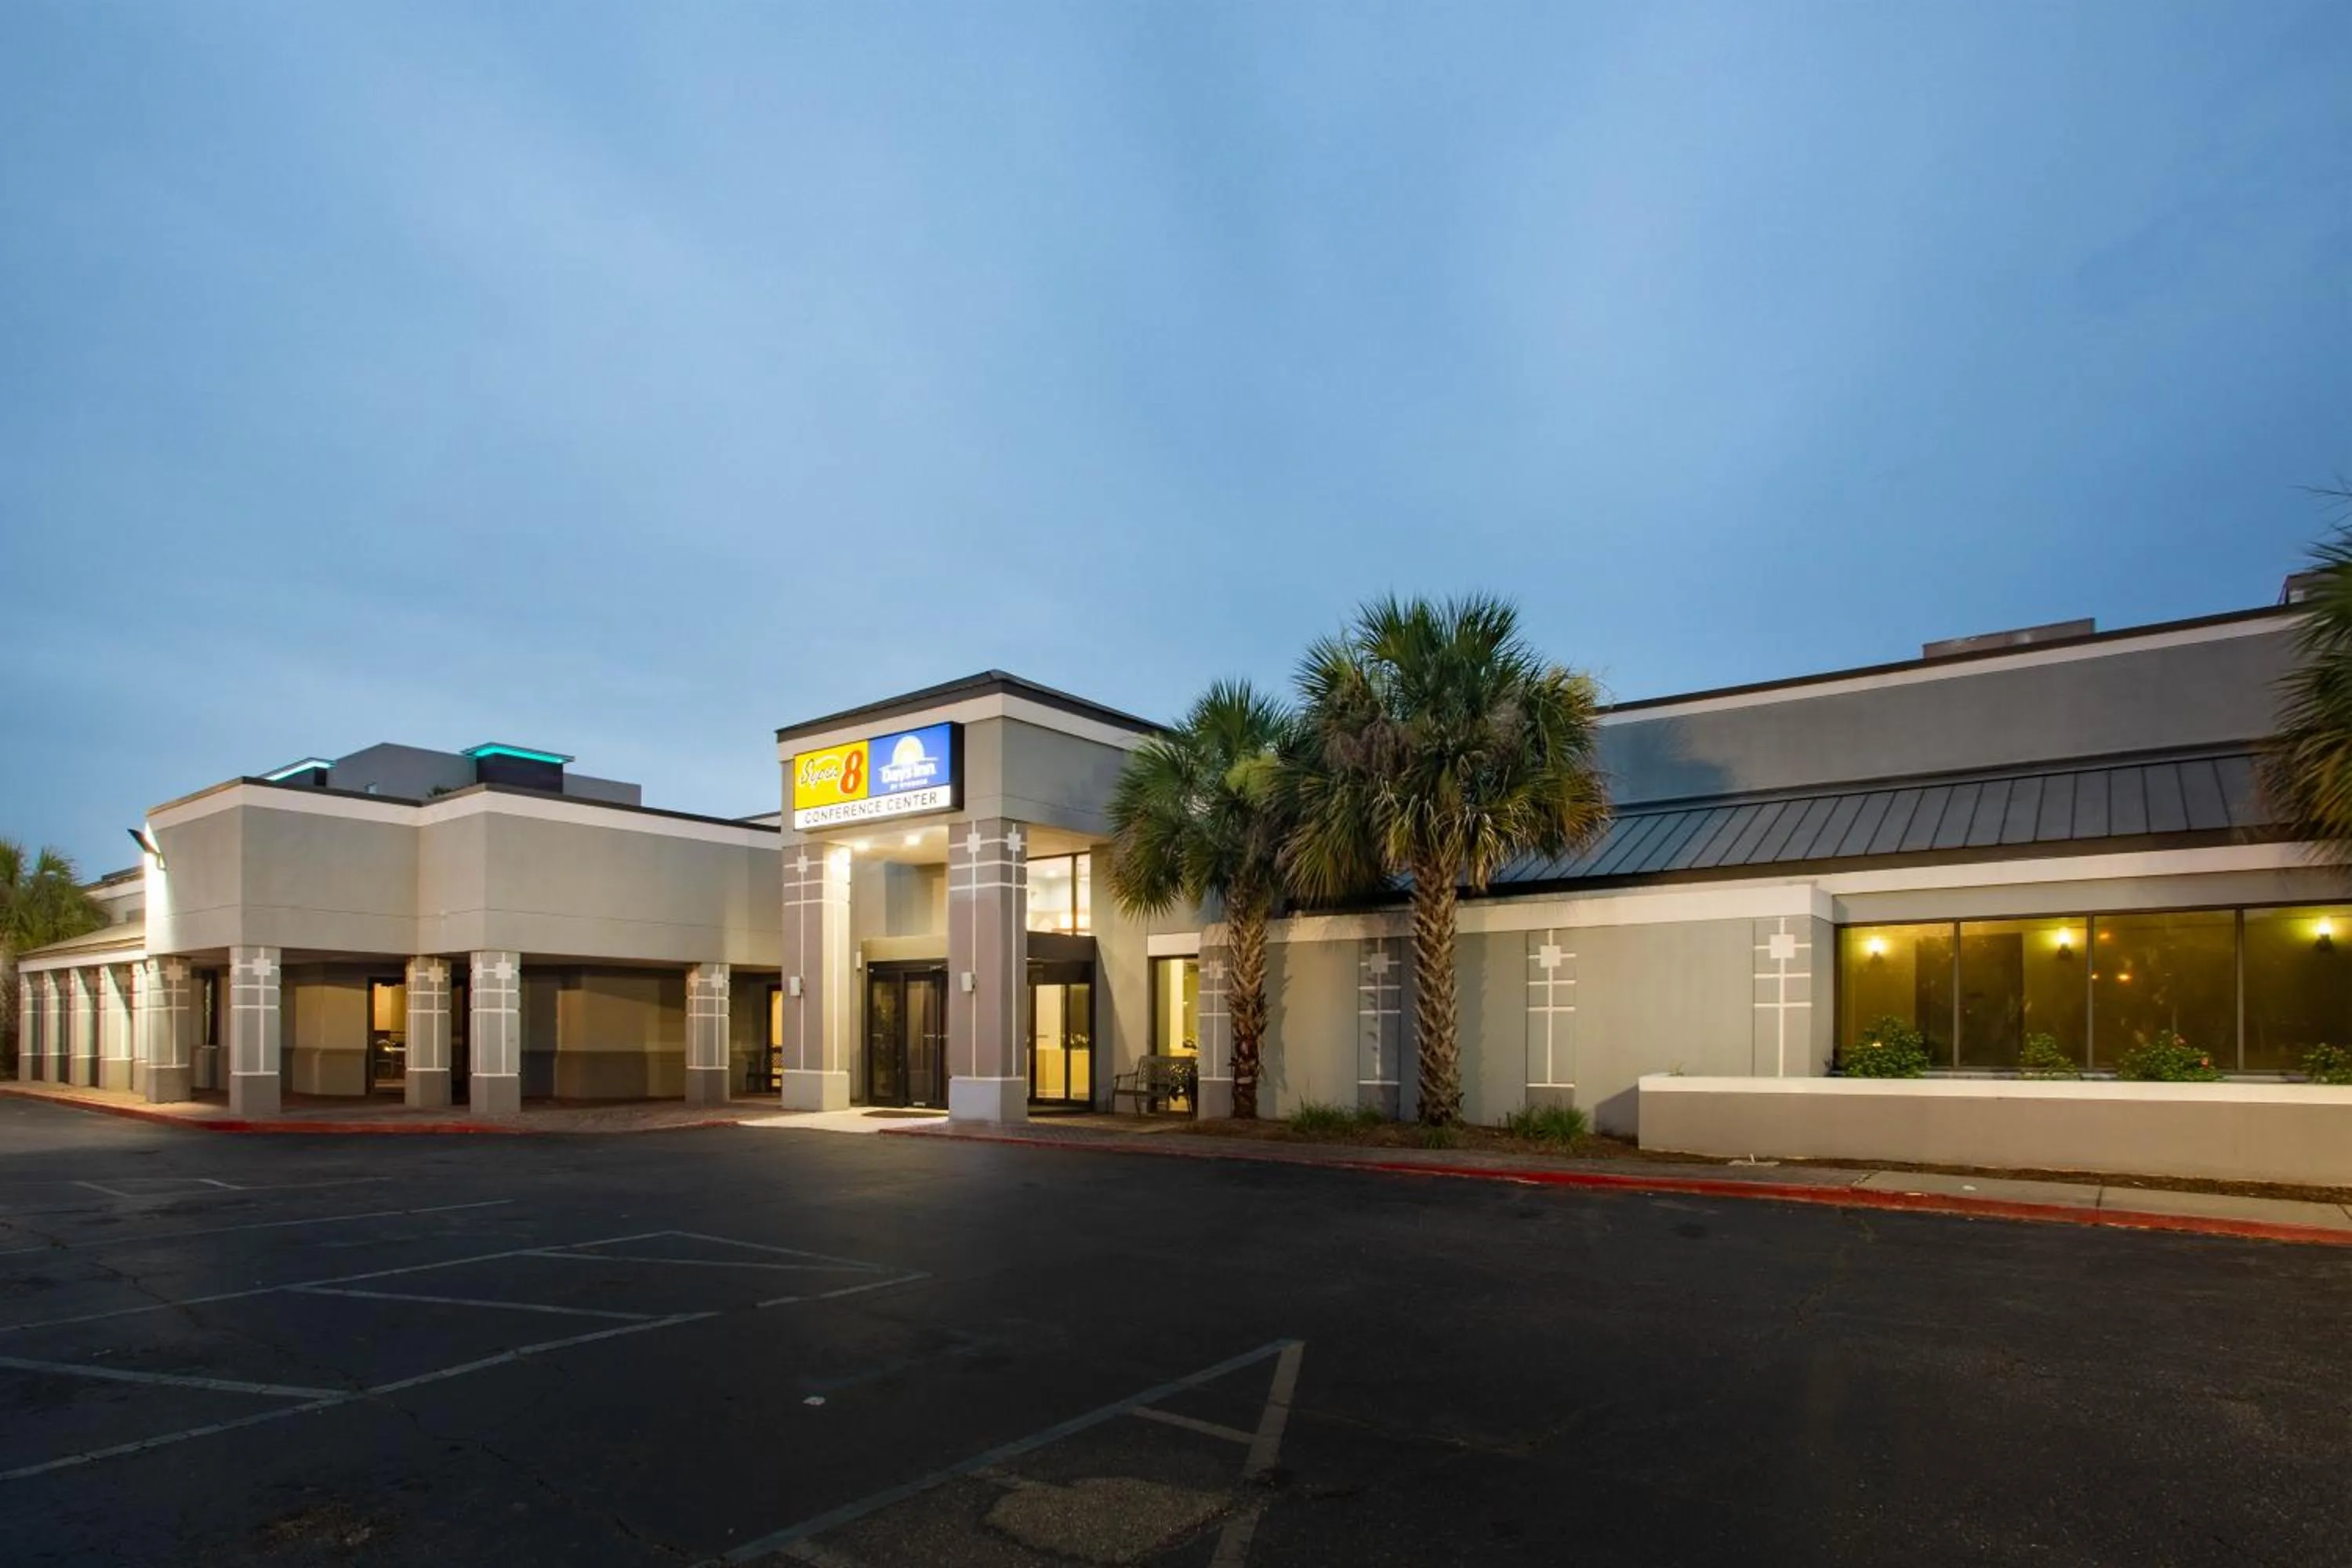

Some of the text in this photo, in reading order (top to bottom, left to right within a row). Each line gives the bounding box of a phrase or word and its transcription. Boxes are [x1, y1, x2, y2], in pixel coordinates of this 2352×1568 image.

[840, 749, 863, 794] 8
[804, 791, 938, 824] CONFERENCE CENTER
